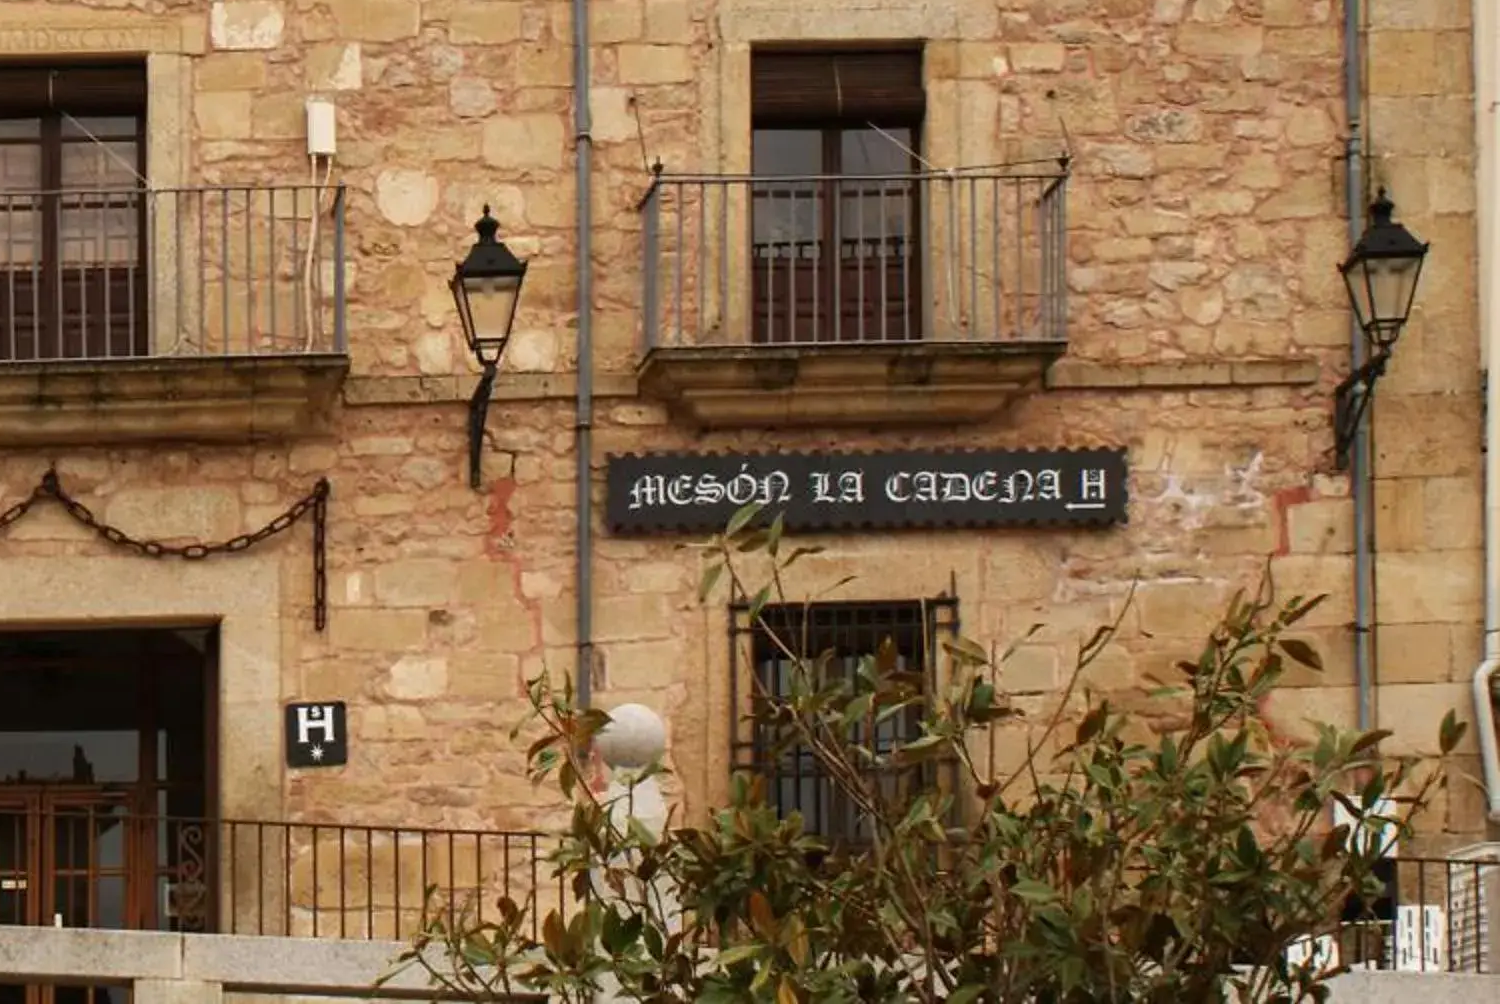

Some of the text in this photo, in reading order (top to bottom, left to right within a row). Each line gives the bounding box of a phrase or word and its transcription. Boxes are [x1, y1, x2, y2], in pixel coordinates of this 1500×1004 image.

[628, 463, 792, 510] MESÓN
[809, 468, 867, 503] LA
[885, 468, 1063, 503] CADENA
